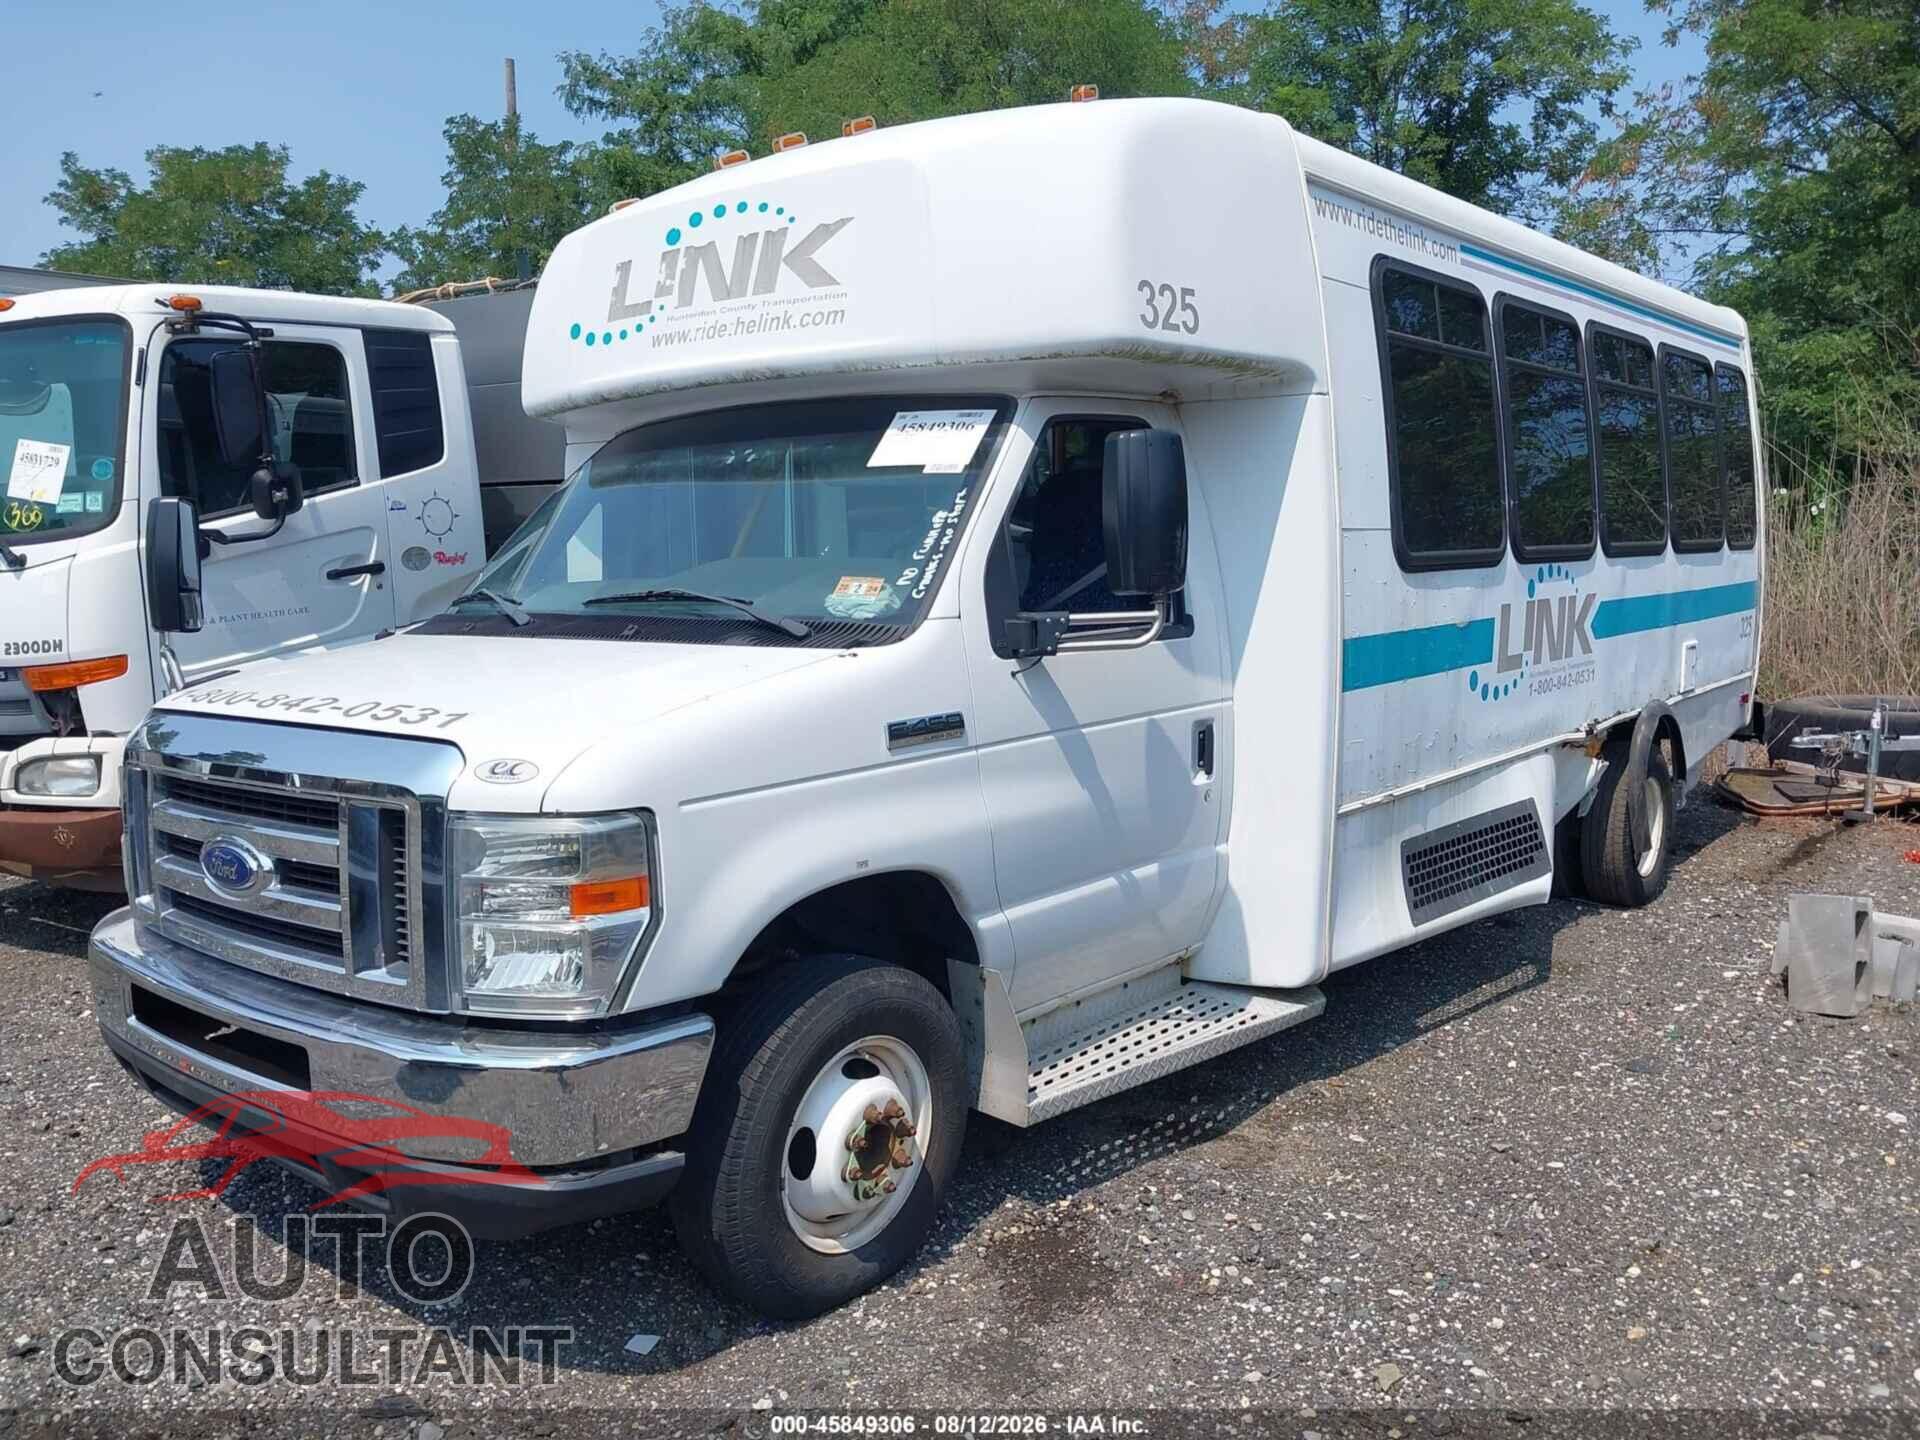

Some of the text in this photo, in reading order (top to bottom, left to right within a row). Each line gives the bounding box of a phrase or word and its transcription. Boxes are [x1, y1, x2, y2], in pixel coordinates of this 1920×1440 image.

[1313, 196, 1458, 263] www.ridethelink.com
[608, 217, 855, 323] LINK
[720, 302, 758, 315] County
[762, 292, 848, 308] Transportation
[1137, 279, 1200, 335] 325
[651, 309, 846, 349] www.ridehelink.com
[897, 420, 976, 433] 45849306
[219, 613, 248, 624] PLANT
[251, 609, 286, 620] HEALTH
[287, 606, 310, 616] CARE
[1497, 592, 1597, 674] LINK
[4, 640, 63, 656] 2300DH
[1529, 667, 1596, 697] 1-800-842-0531
[171, 689, 469, 728] 1-800-842-0531
